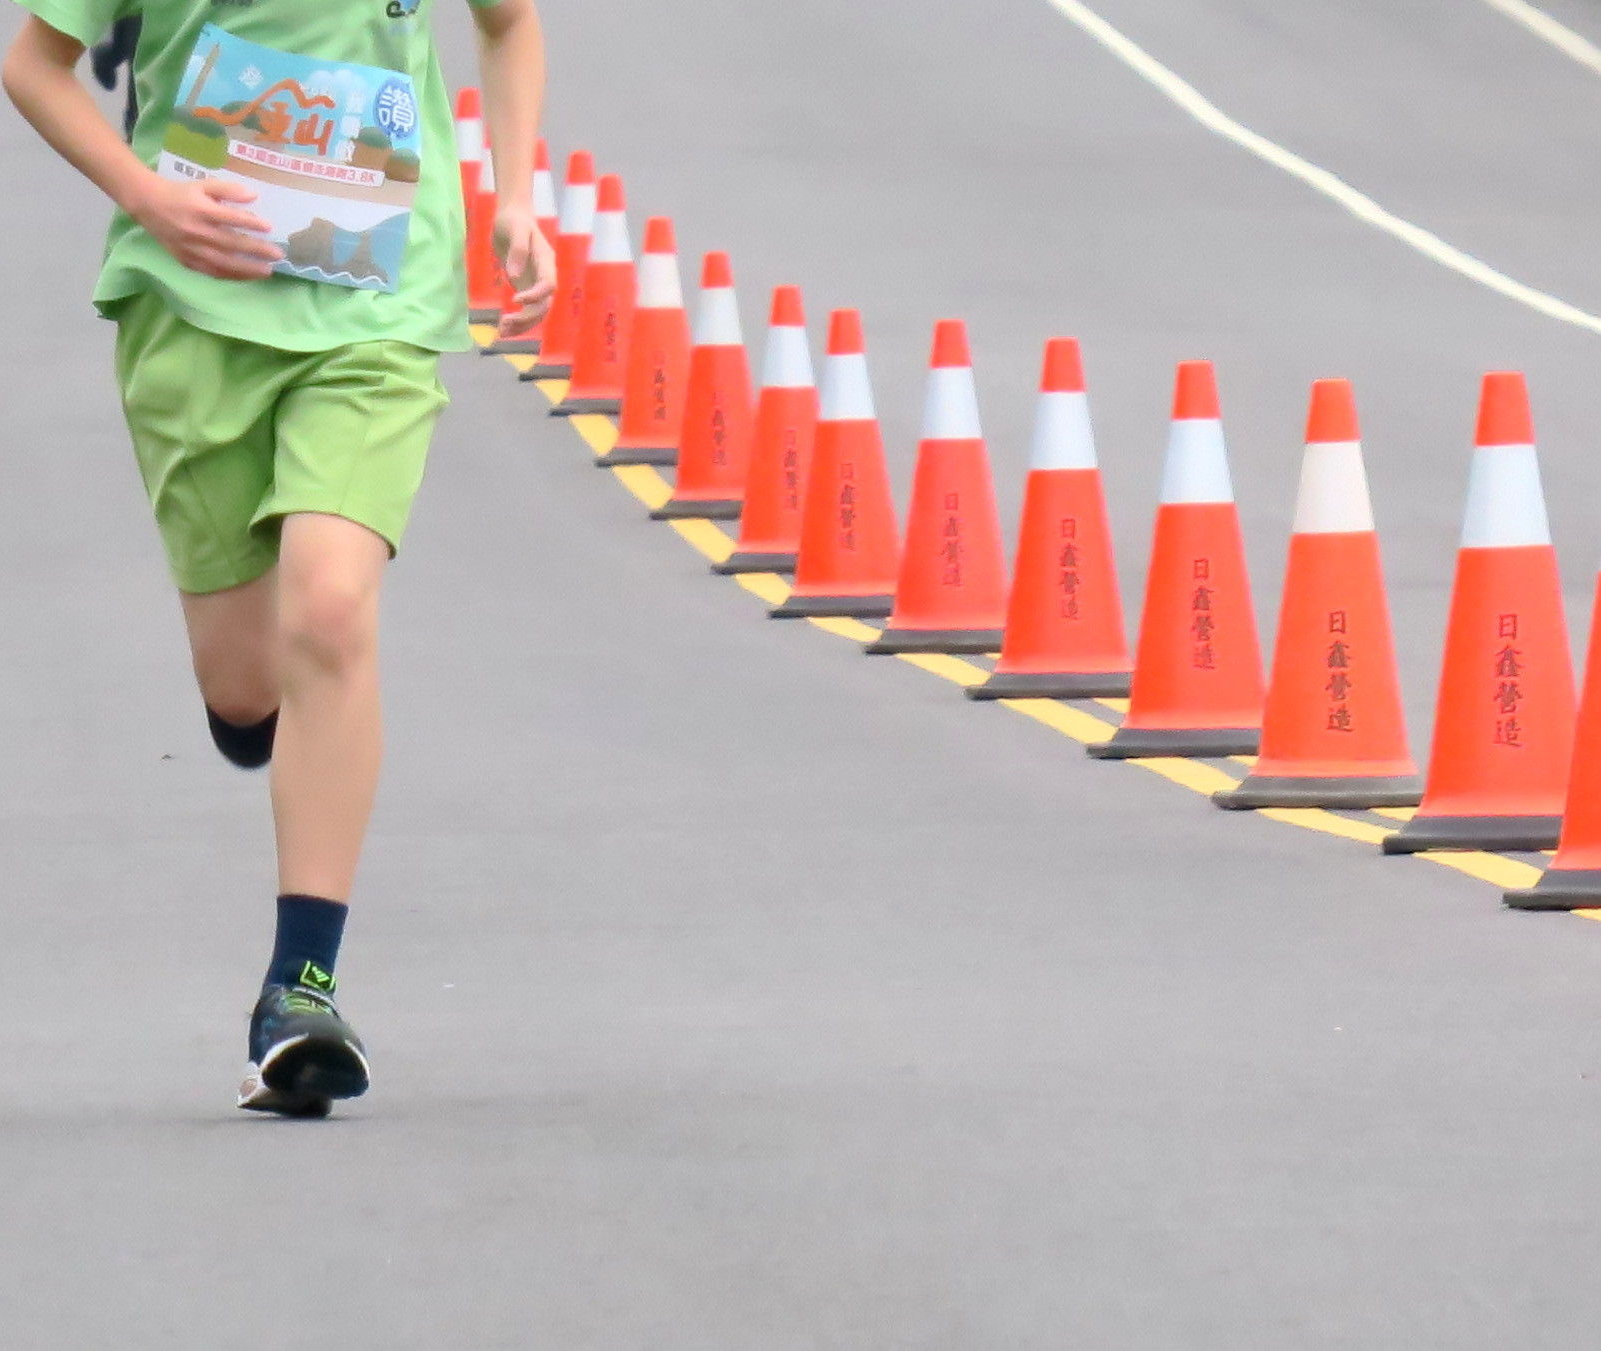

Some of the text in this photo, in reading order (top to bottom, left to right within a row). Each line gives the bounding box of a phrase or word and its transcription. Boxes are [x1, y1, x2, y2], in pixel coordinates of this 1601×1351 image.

[1191, 558, 1216, 670] 日鑫營造
[1325, 610, 1355, 732] 日鑫營造
[1493, 613, 1524, 748] 日鑫營造
